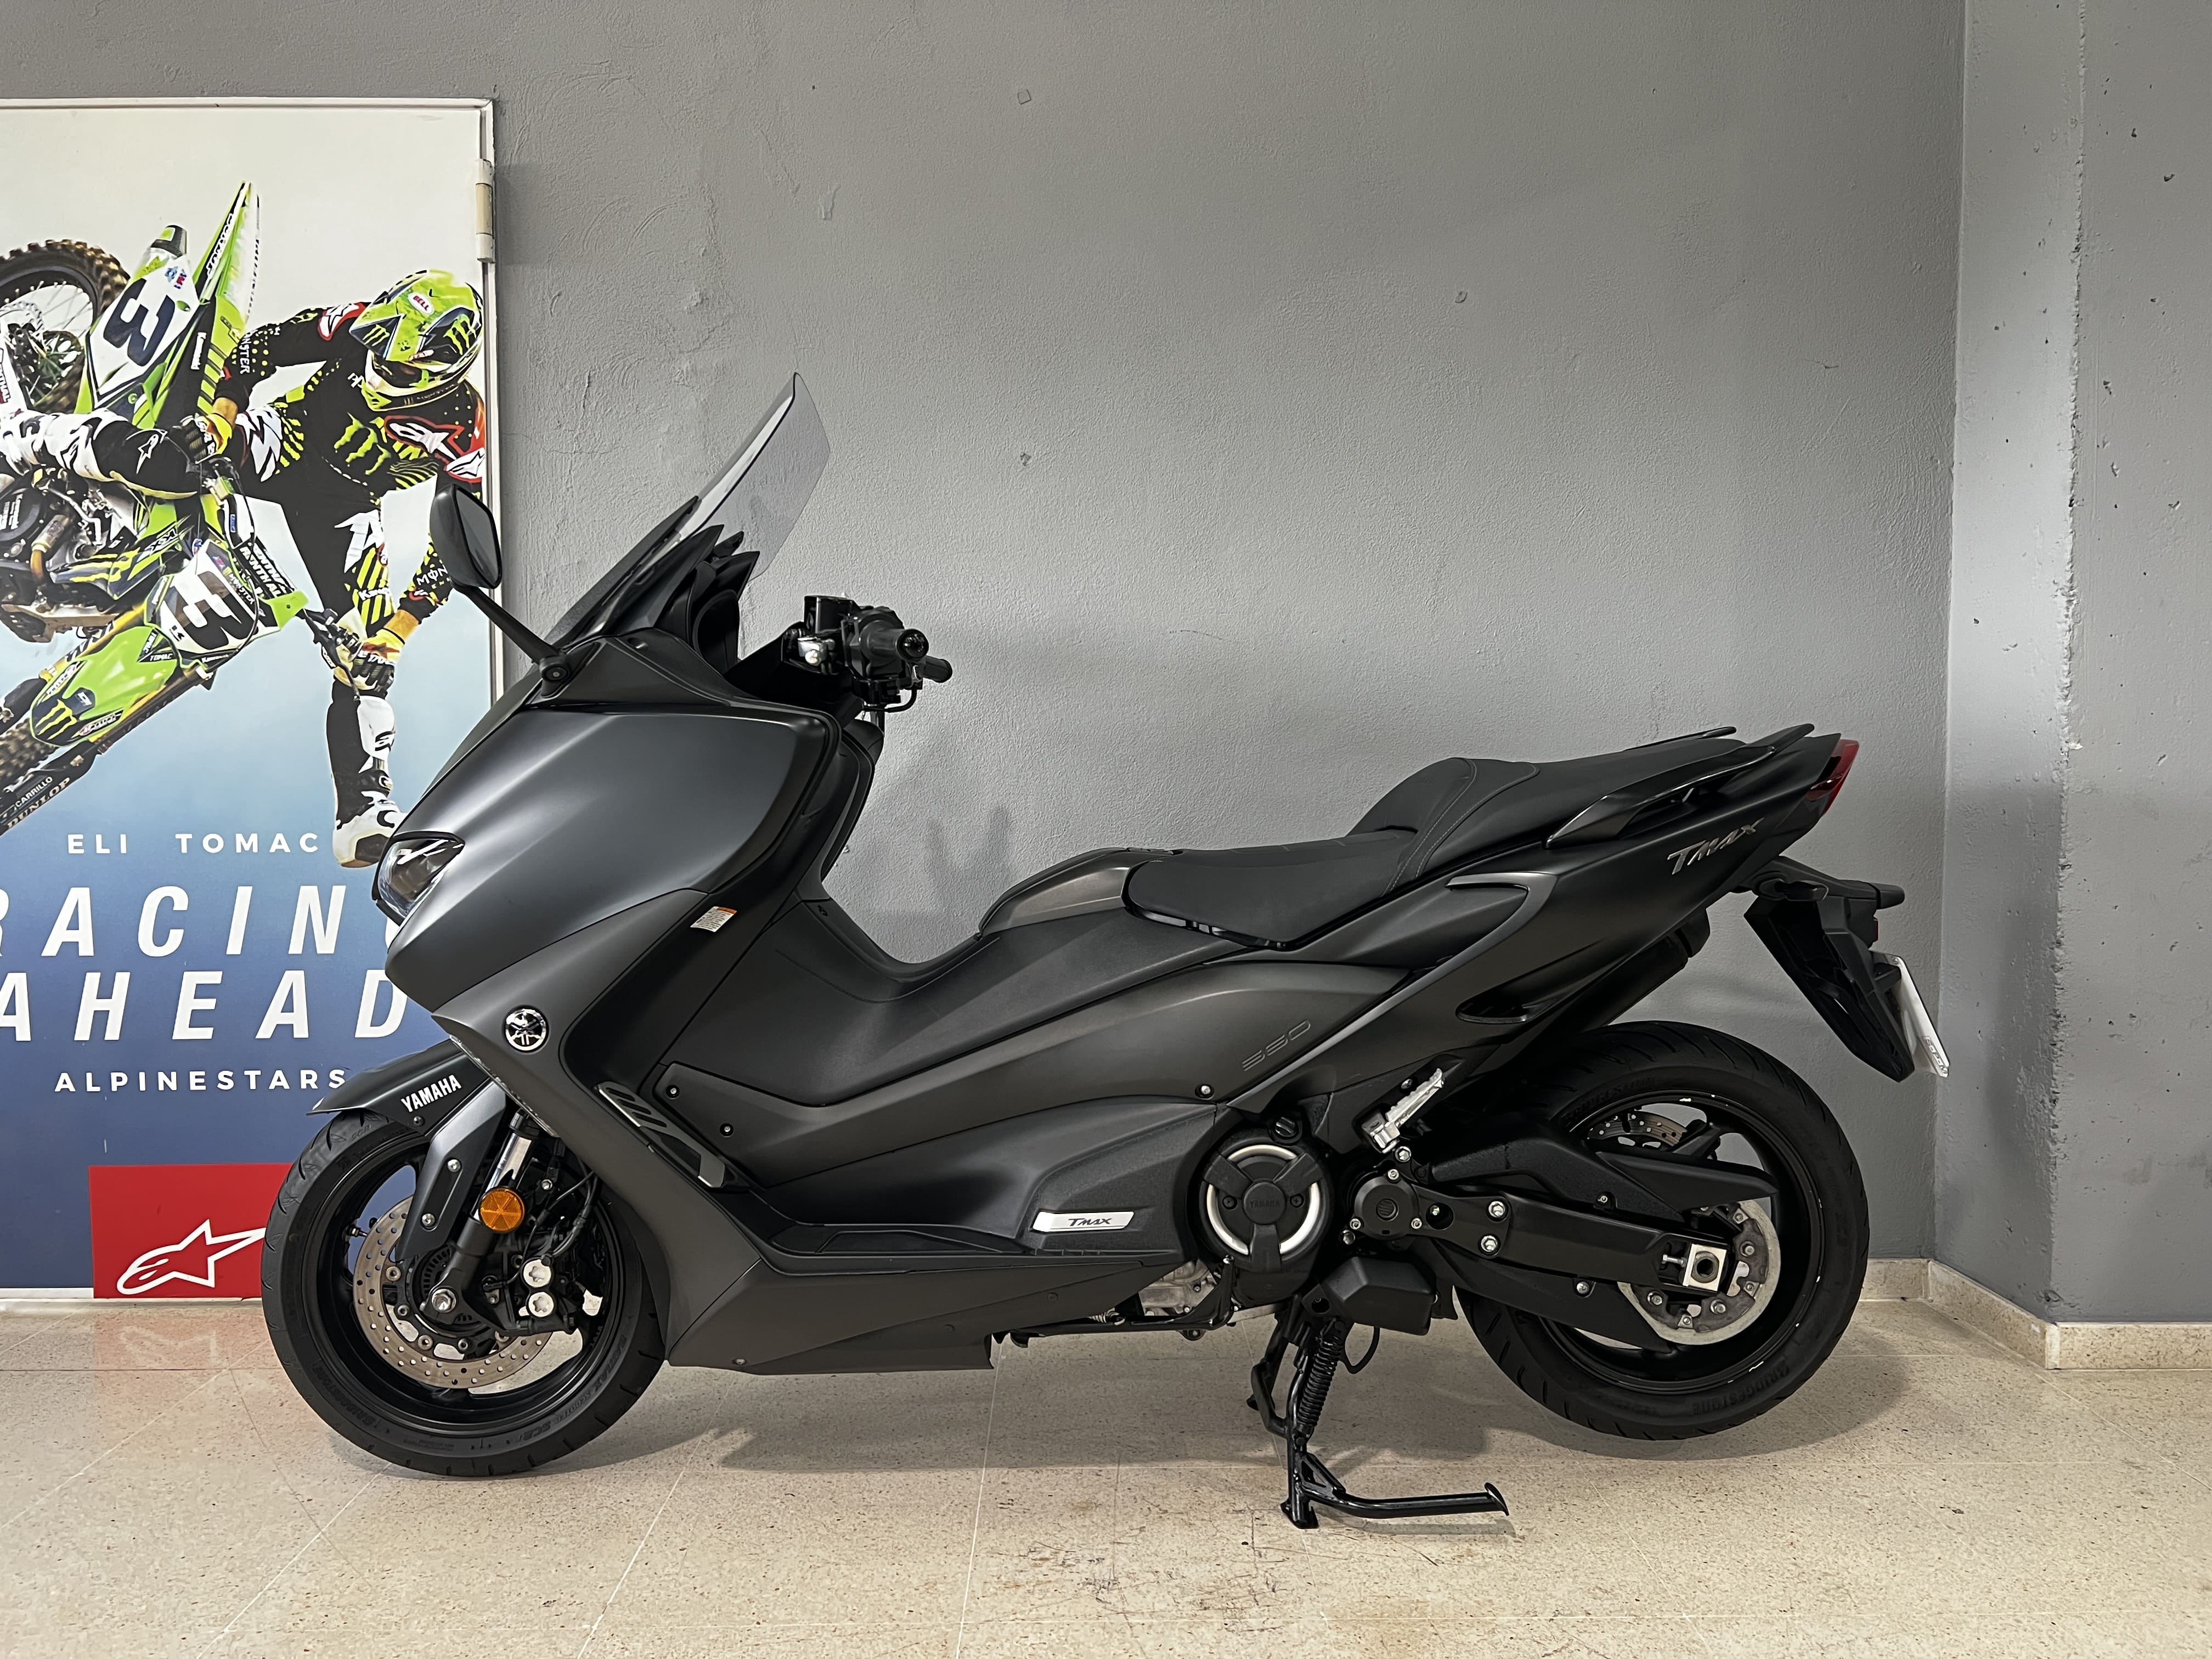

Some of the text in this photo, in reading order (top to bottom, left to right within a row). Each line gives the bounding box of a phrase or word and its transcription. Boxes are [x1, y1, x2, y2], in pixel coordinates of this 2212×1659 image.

[413, 295, 429, 311] BELL
[239, 331, 251, 375] ONSTER
[7, 777, 70, 828] DUNLOP
[15, 776, 53, 808] CARRILLO
[67, 832, 320, 855] ELI TOMAC
[1667, 817, 1764, 875] TMAX
[0, 885, 400, 957] ACIN
[0, 969, 407, 1042] AHEAD
[54, 1069, 346, 1093] ALPINESTARS
[400, 1075, 461, 1113] YAMAHA
[1068, 1217, 1113, 1227] TMAX
